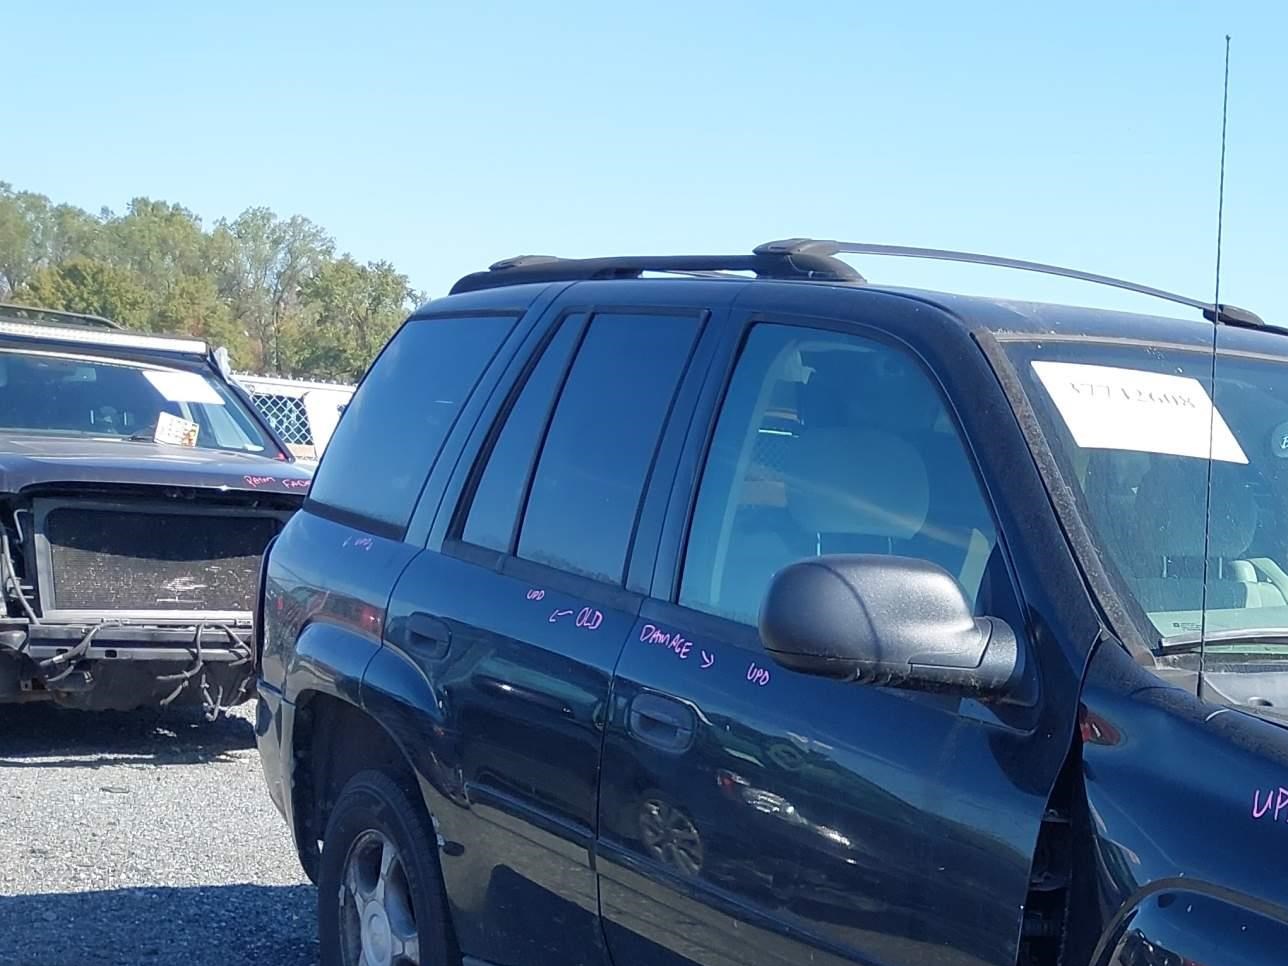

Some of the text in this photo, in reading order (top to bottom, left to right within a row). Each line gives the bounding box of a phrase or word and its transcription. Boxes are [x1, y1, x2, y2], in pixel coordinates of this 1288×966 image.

[575, 606, 693, 659] OLD DAMAGE
[746, 662, 770, 686] UPD
